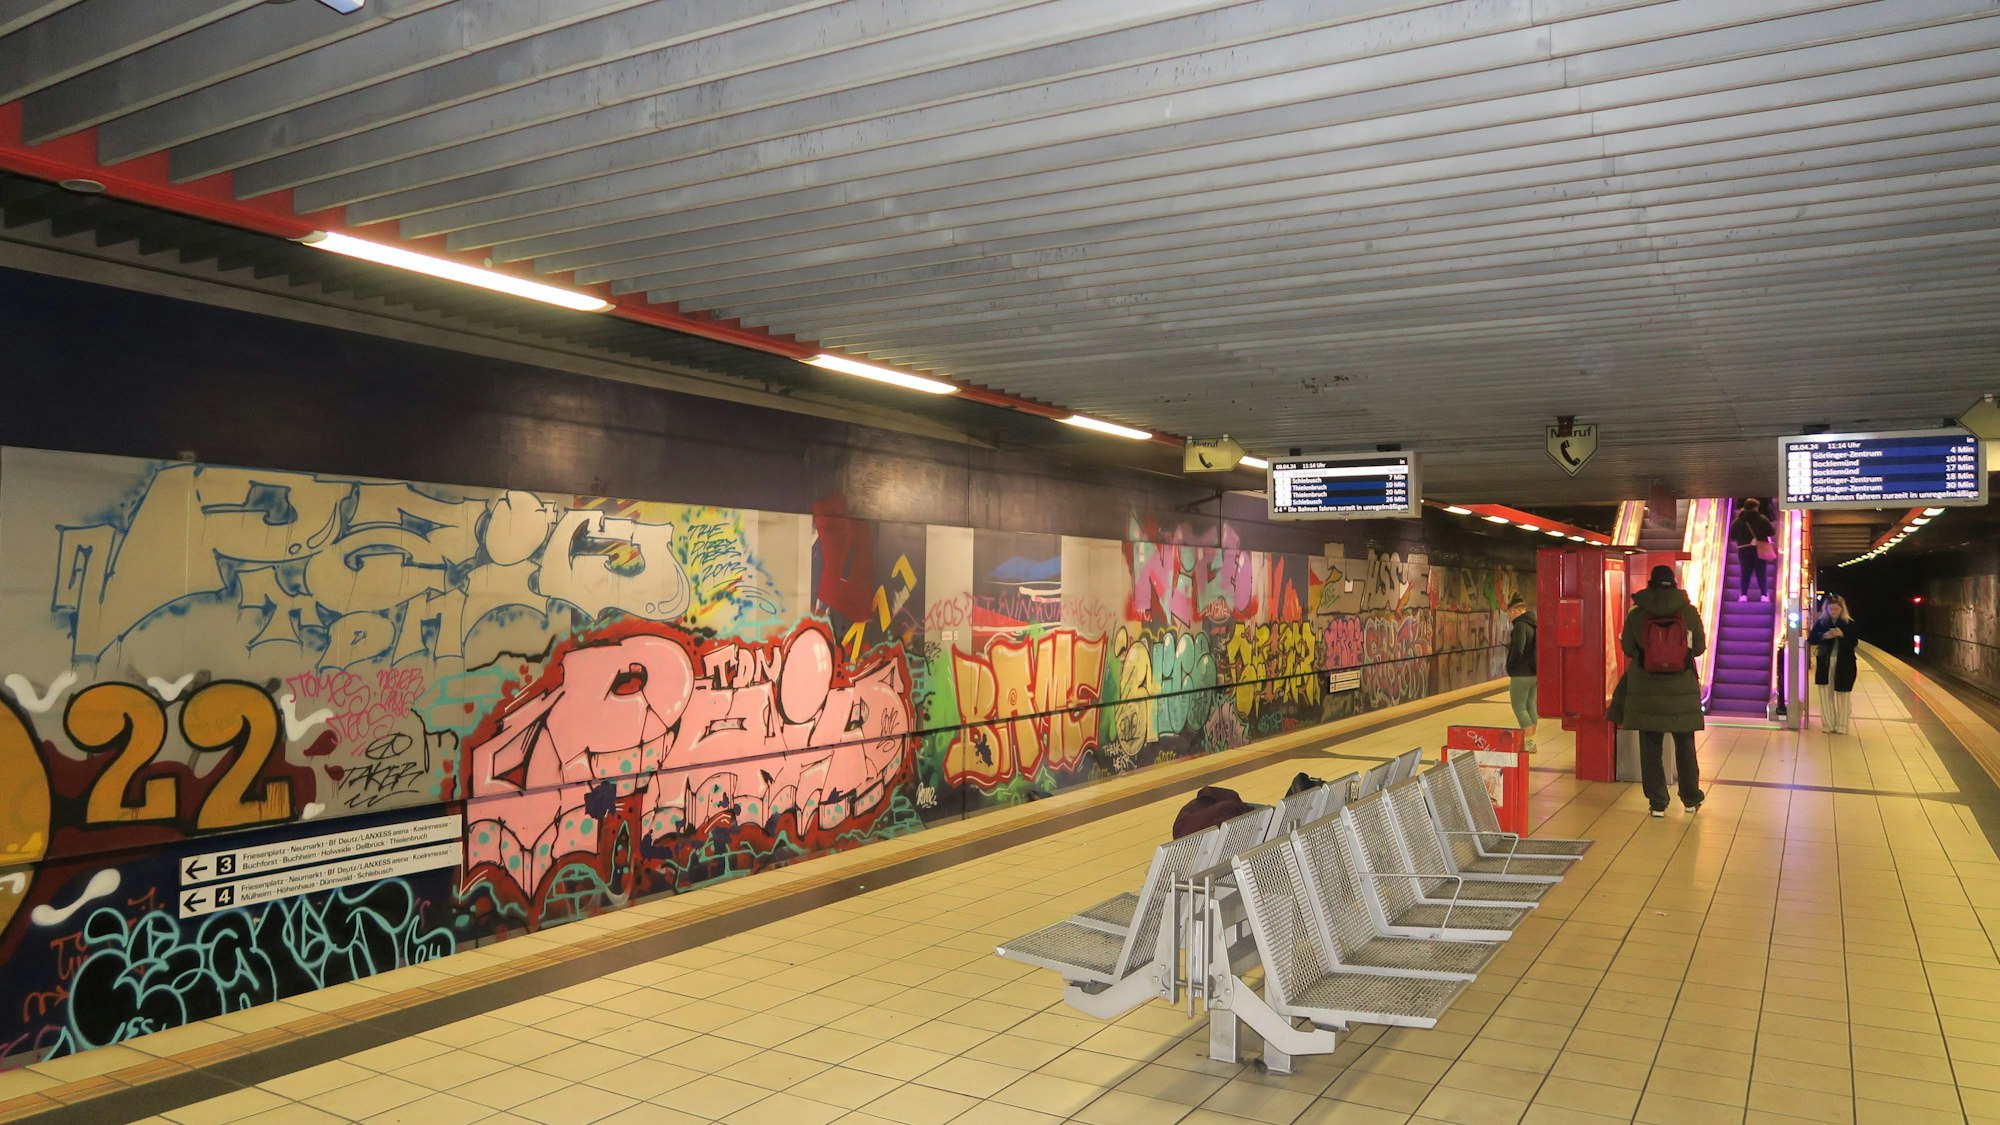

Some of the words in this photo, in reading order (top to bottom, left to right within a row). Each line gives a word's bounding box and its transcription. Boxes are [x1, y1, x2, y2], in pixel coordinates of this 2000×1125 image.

[1550, 425, 1592, 439] Nruf
[1193, 440, 1219, 448] Notruf
[1958, 463, 1974, 471] Min
[1958, 472, 1974, 480] Min
[1958, 481, 1974, 489] Min
[1856, 493, 1880, 501] fahren
[1919, 490, 1978, 499] unregelmäßige
[220, 857, 233, 874] 3
[242, 848, 286, 861] Friesenplatz
[290, 842, 324, 853] Neumarkt
[328, 838, 336, 846] Bf
[338, 829, 392, 845] Deutz/LANXESS
[413, 822, 448, 833] Koelnmesse
[242, 860, 278, 870] Buchforst
[282, 853, 317, 863] Buchheim
[321, 846, 352, 857] Holweide
[356, 841, 385, 851] Dellbrück
[390, 834, 428, 845] Thielenbruch
[218, 889, 231, 906] 4
[241, 879, 284, 892] Friesenplatz
[288, 872, 322, 883] Neumarkt
[337, 858, 391, 874] Deutz/LANXESS
[412, 850, 448, 860] Koelnmesse
[240, 891, 272, 902] Mülheim
[319, 875, 353, 886] Dünnwald
[357, 868, 393, 879] Schlebusch
